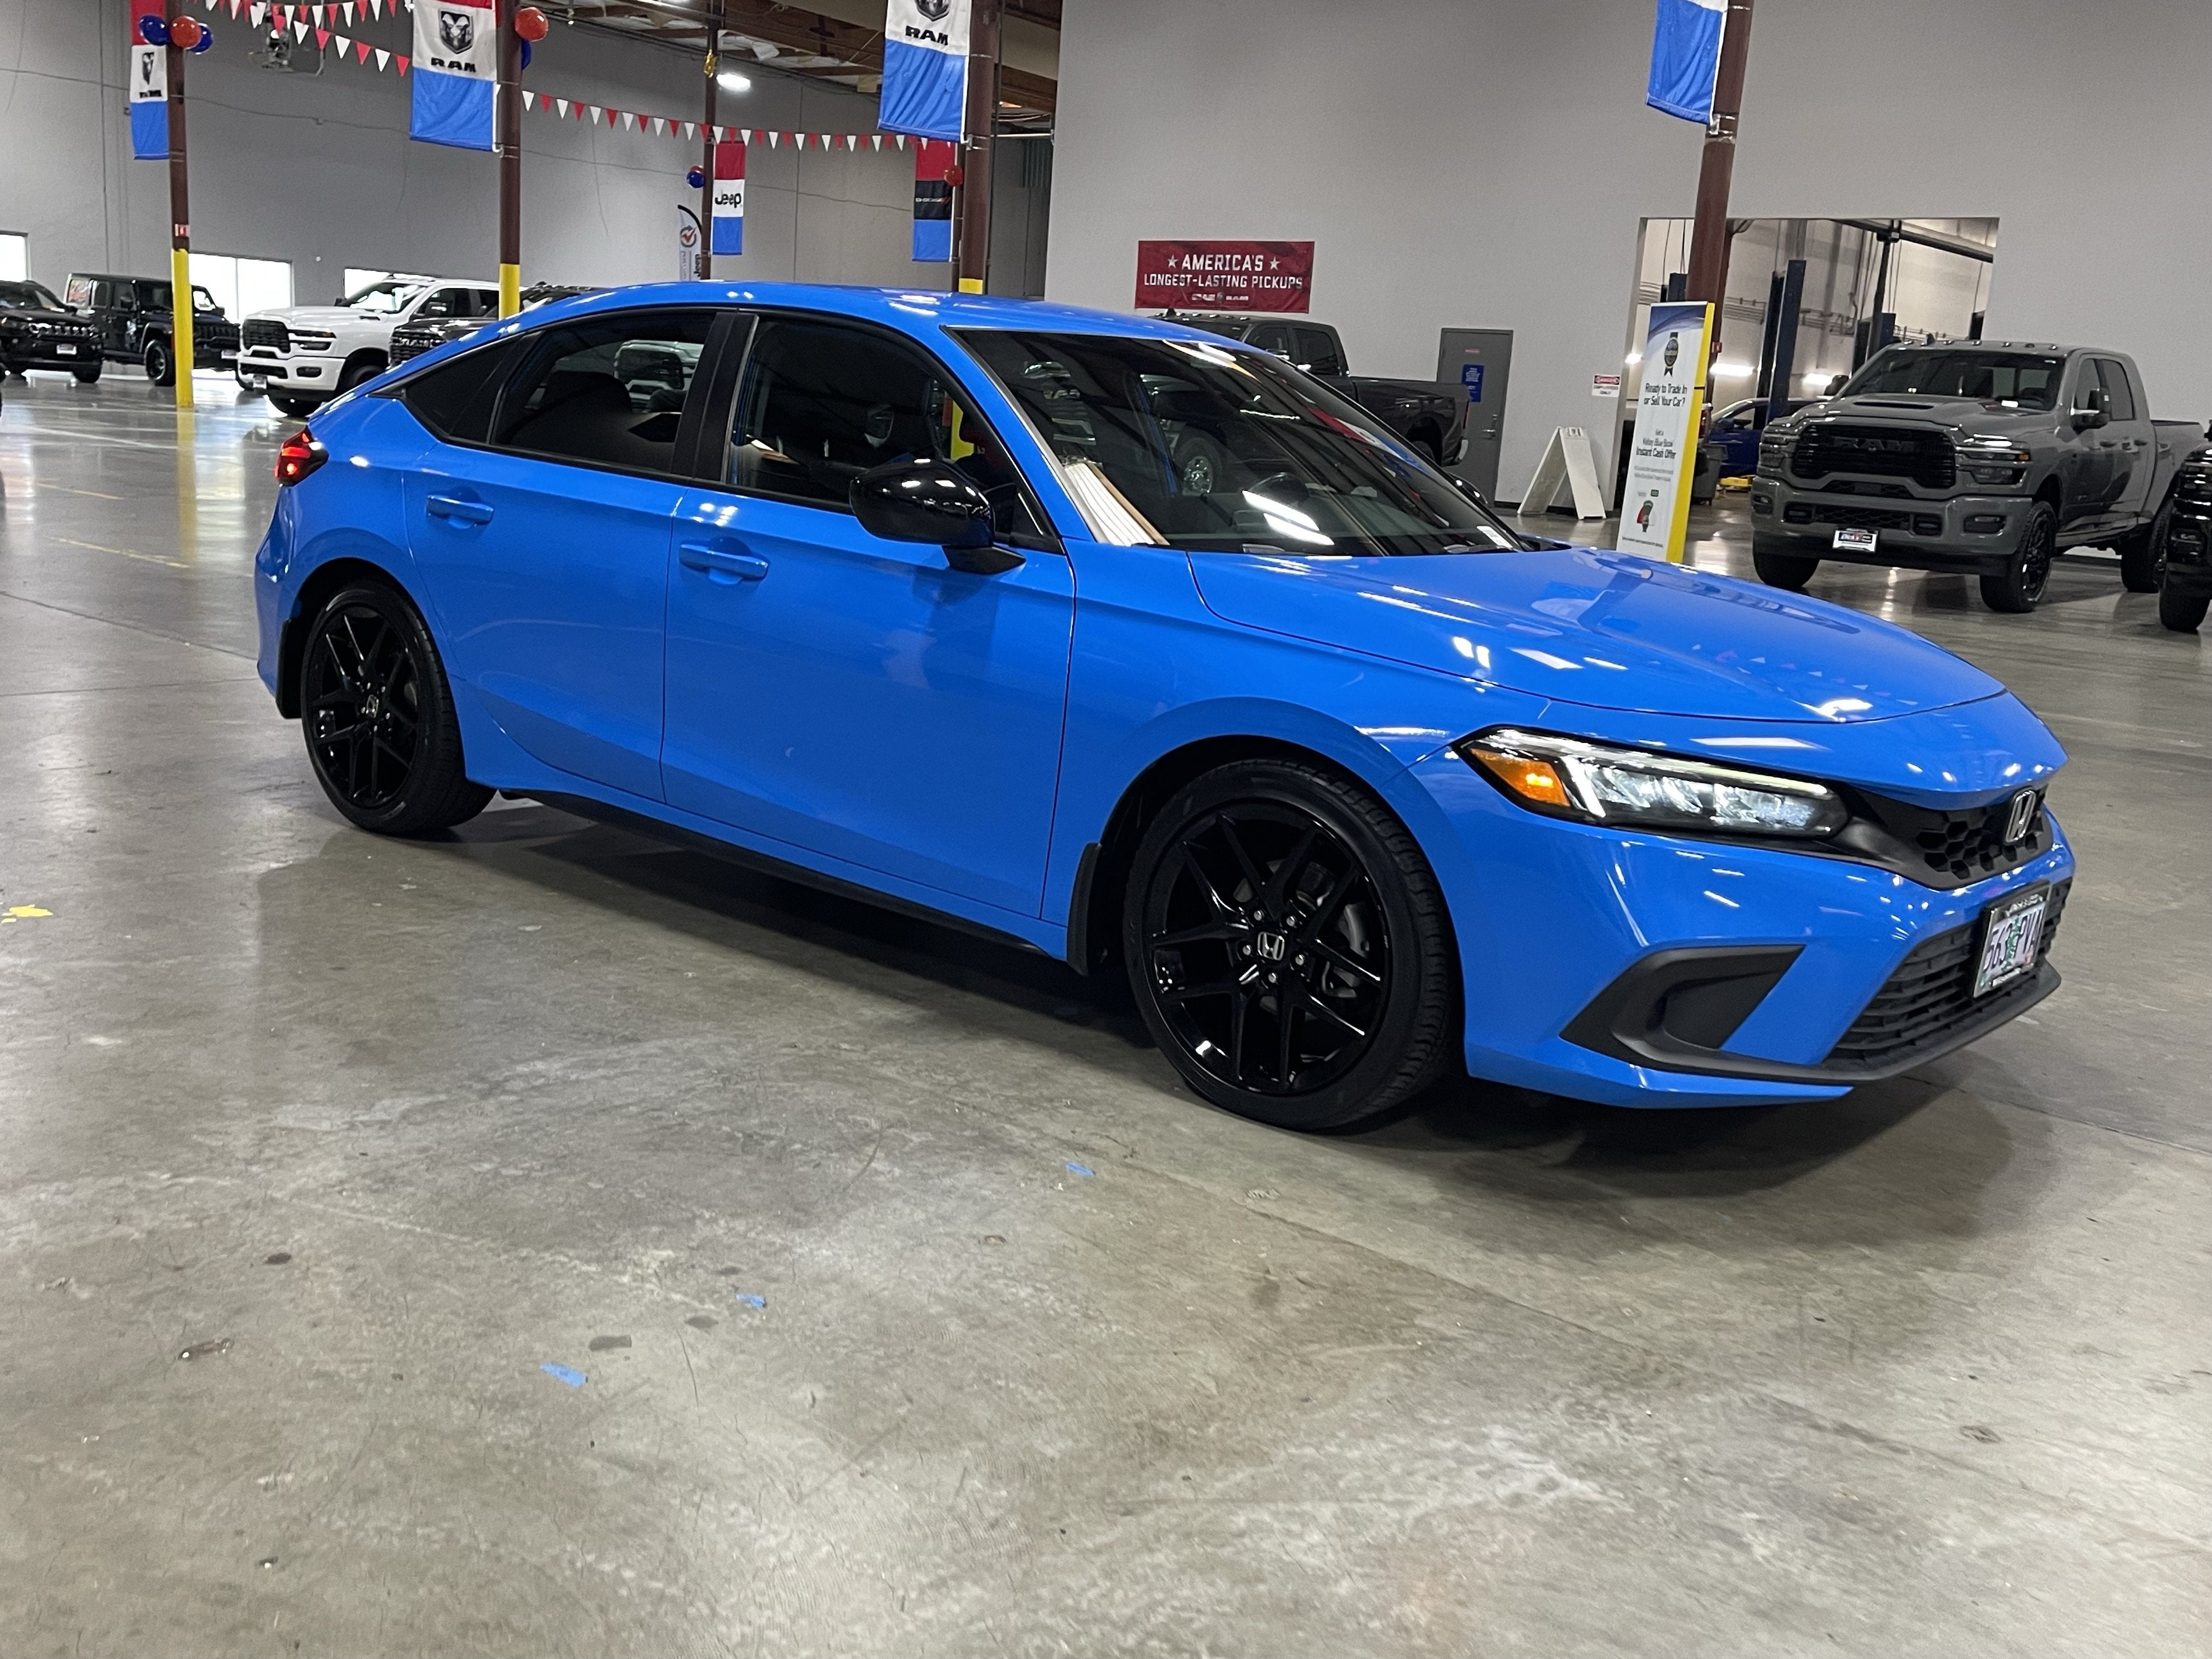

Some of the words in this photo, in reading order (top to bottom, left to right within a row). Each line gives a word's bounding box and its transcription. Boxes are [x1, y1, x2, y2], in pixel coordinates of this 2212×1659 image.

[905, 25, 948, 46] RAM
[431, 57, 476, 72] RAM
[714, 190, 742, 208] Jeep
[1181, 254, 1264, 272] AMERICA'S
[1144, 274, 1248, 288] LONGEST-LASTING
[1251, 276, 1302, 289] PICKUPS
